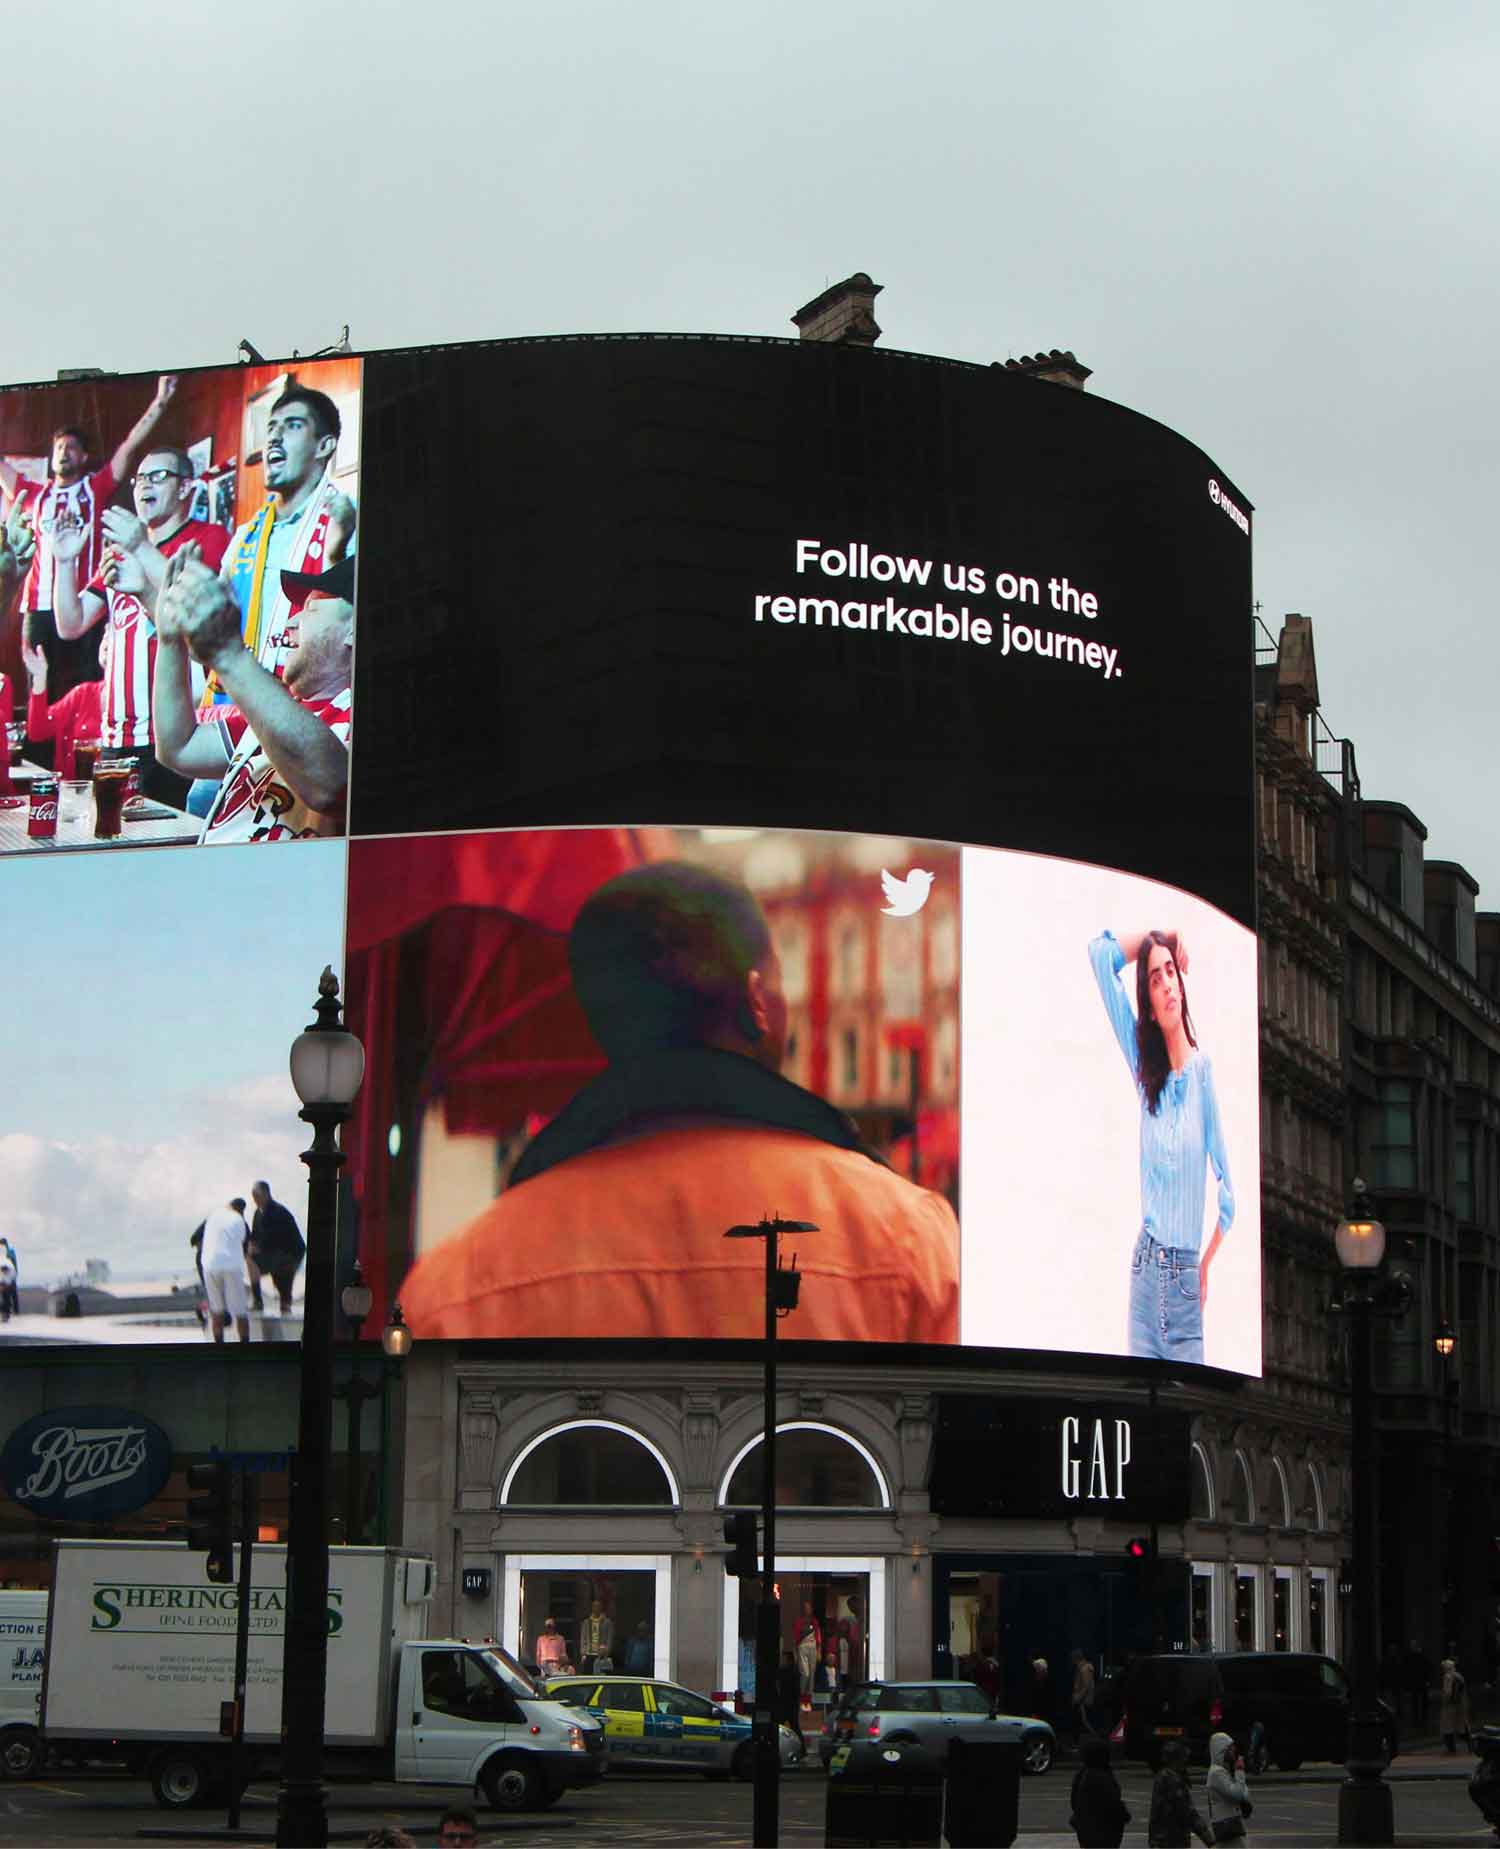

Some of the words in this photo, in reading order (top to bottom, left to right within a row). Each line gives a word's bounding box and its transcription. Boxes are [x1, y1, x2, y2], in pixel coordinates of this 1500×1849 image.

[796, 540, 933, 586] Follow
[943, 563, 986, 595] us
[995, 573, 1040, 605] on
[1047, 577, 1098, 619] the
[755, 596, 993, 645] remarkable
[1000, 612, 1122, 680] journey.
[16, 1426, 147, 1499] Boots
[1062, 1416, 1131, 1500] GAP
